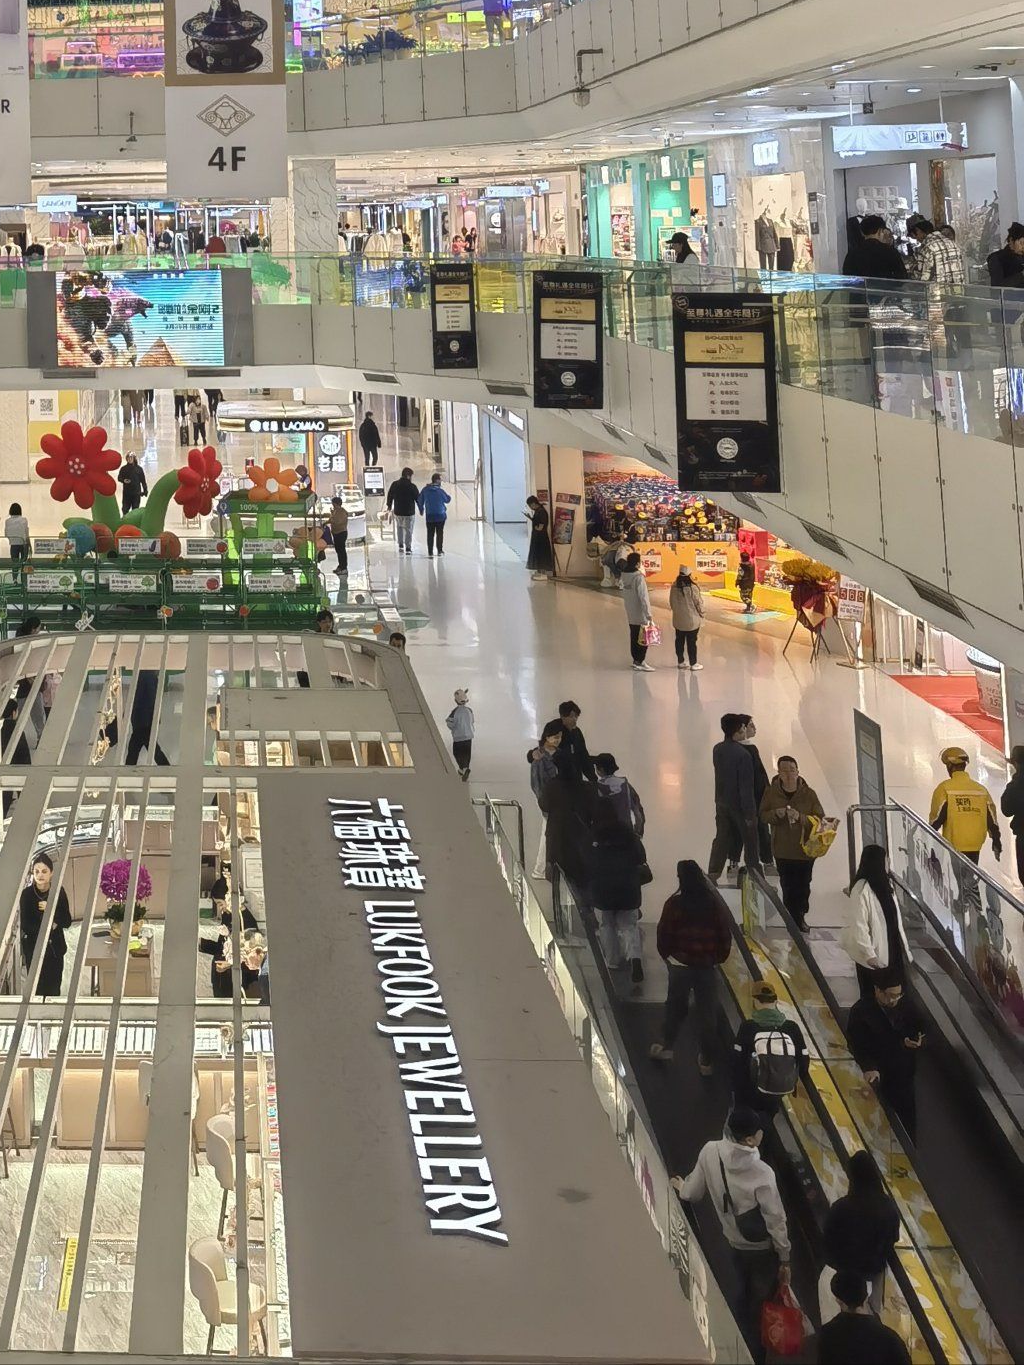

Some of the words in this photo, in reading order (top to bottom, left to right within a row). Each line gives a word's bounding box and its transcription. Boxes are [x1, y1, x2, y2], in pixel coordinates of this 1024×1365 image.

[207, 146, 247, 172] 4F
[282, 419, 325, 432] LAOMIAO
[317, 454, 347, 473] 老庙
[363, 899, 448, 1020] LUKFOOK
[376, 1020, 510, 1247] JEWELLERY
